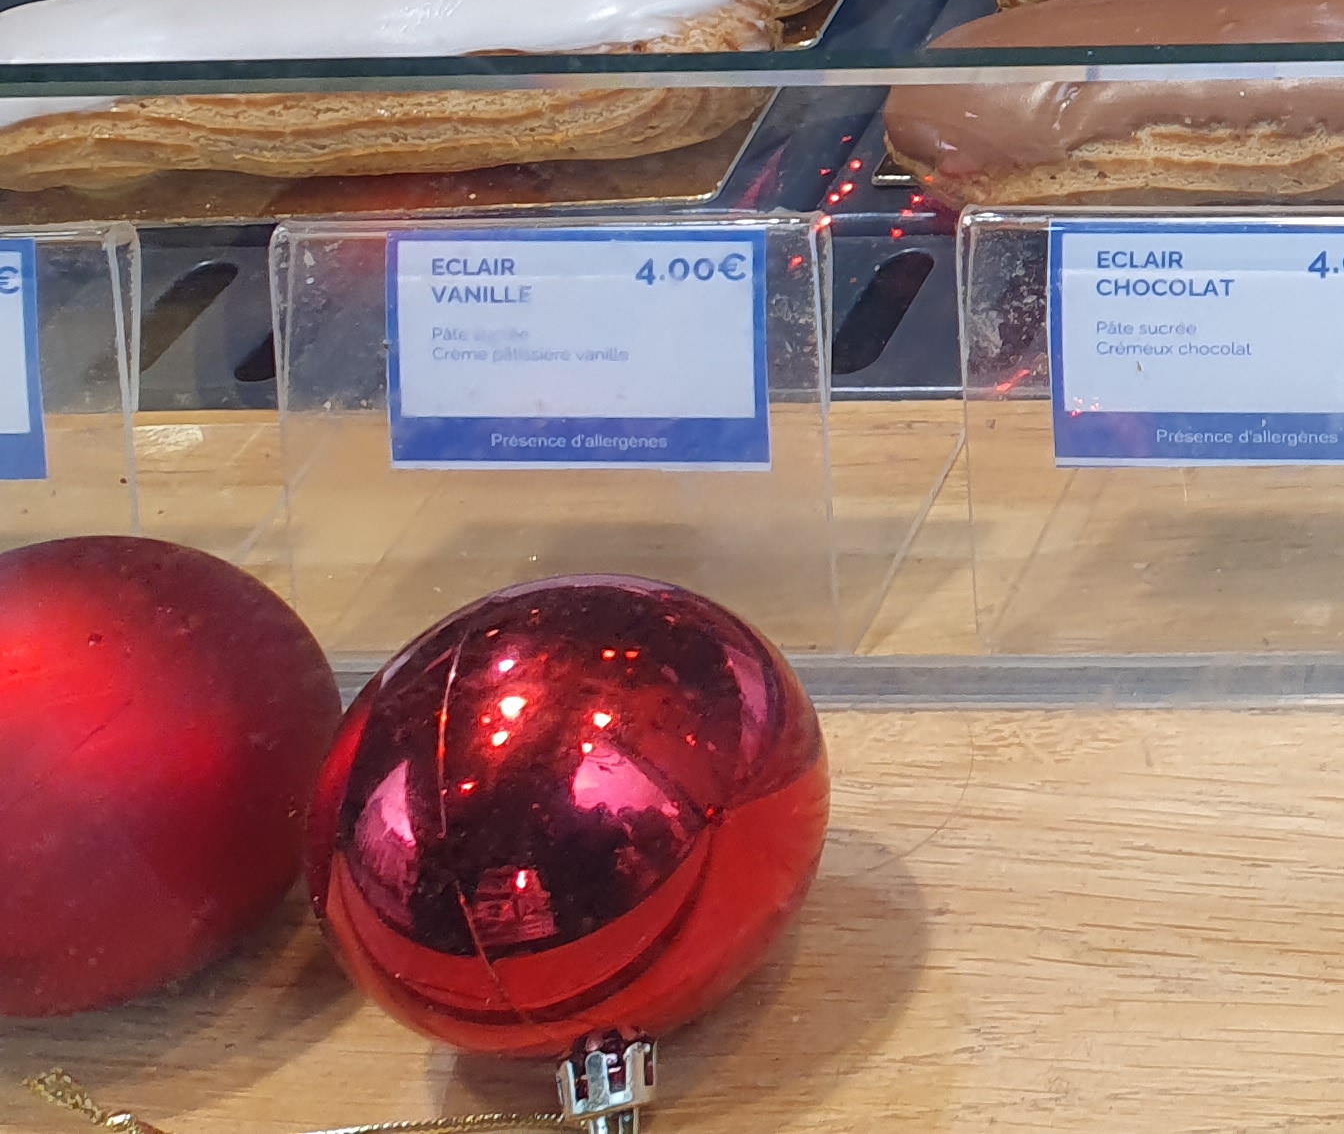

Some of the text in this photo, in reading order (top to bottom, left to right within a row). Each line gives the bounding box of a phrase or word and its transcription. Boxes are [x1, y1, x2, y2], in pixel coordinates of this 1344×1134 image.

[431, 257, 516, 276] ECLAIR
[1096, 250, 1184, 269] ECLAIR
[635, 253, 748, 286] 4.00€
[431, 285, 532, 304] VANILLE
[1096, 278, 1235, 297] CHOCOLAT
[1096, 320, 1197, 336] Pâte sucrée
[1178, 341, 1252, 356] chocolat
[490, 432, 567, 448] Présence
[1156, 428, 1233, 444] Présence
